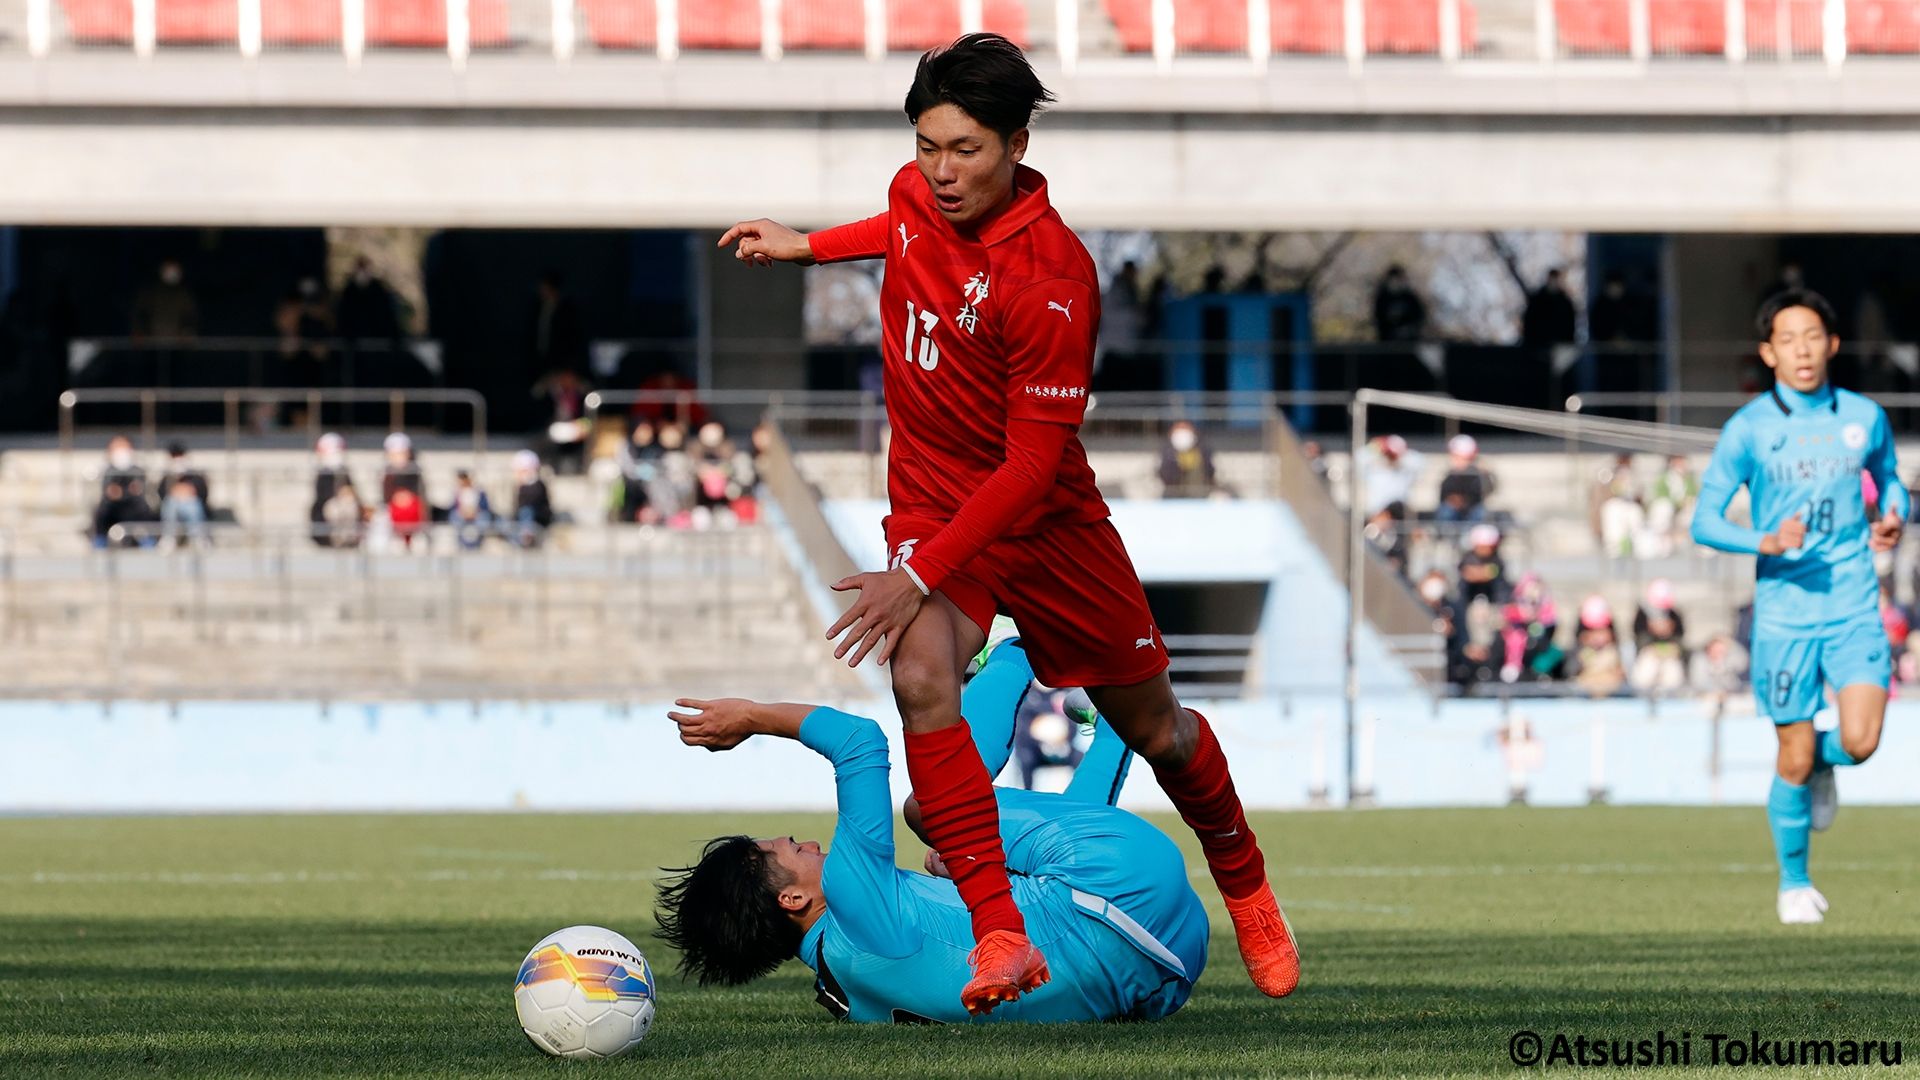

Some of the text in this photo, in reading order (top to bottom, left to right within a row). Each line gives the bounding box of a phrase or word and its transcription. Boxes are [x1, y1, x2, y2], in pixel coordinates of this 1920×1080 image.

[956, 271, 990, 335] 神村
[905, 300, 940, 371] 13
[1025, 385, 1086, 399] いちき串木野市
[577, 948, 642, 966] ALMUNDO
